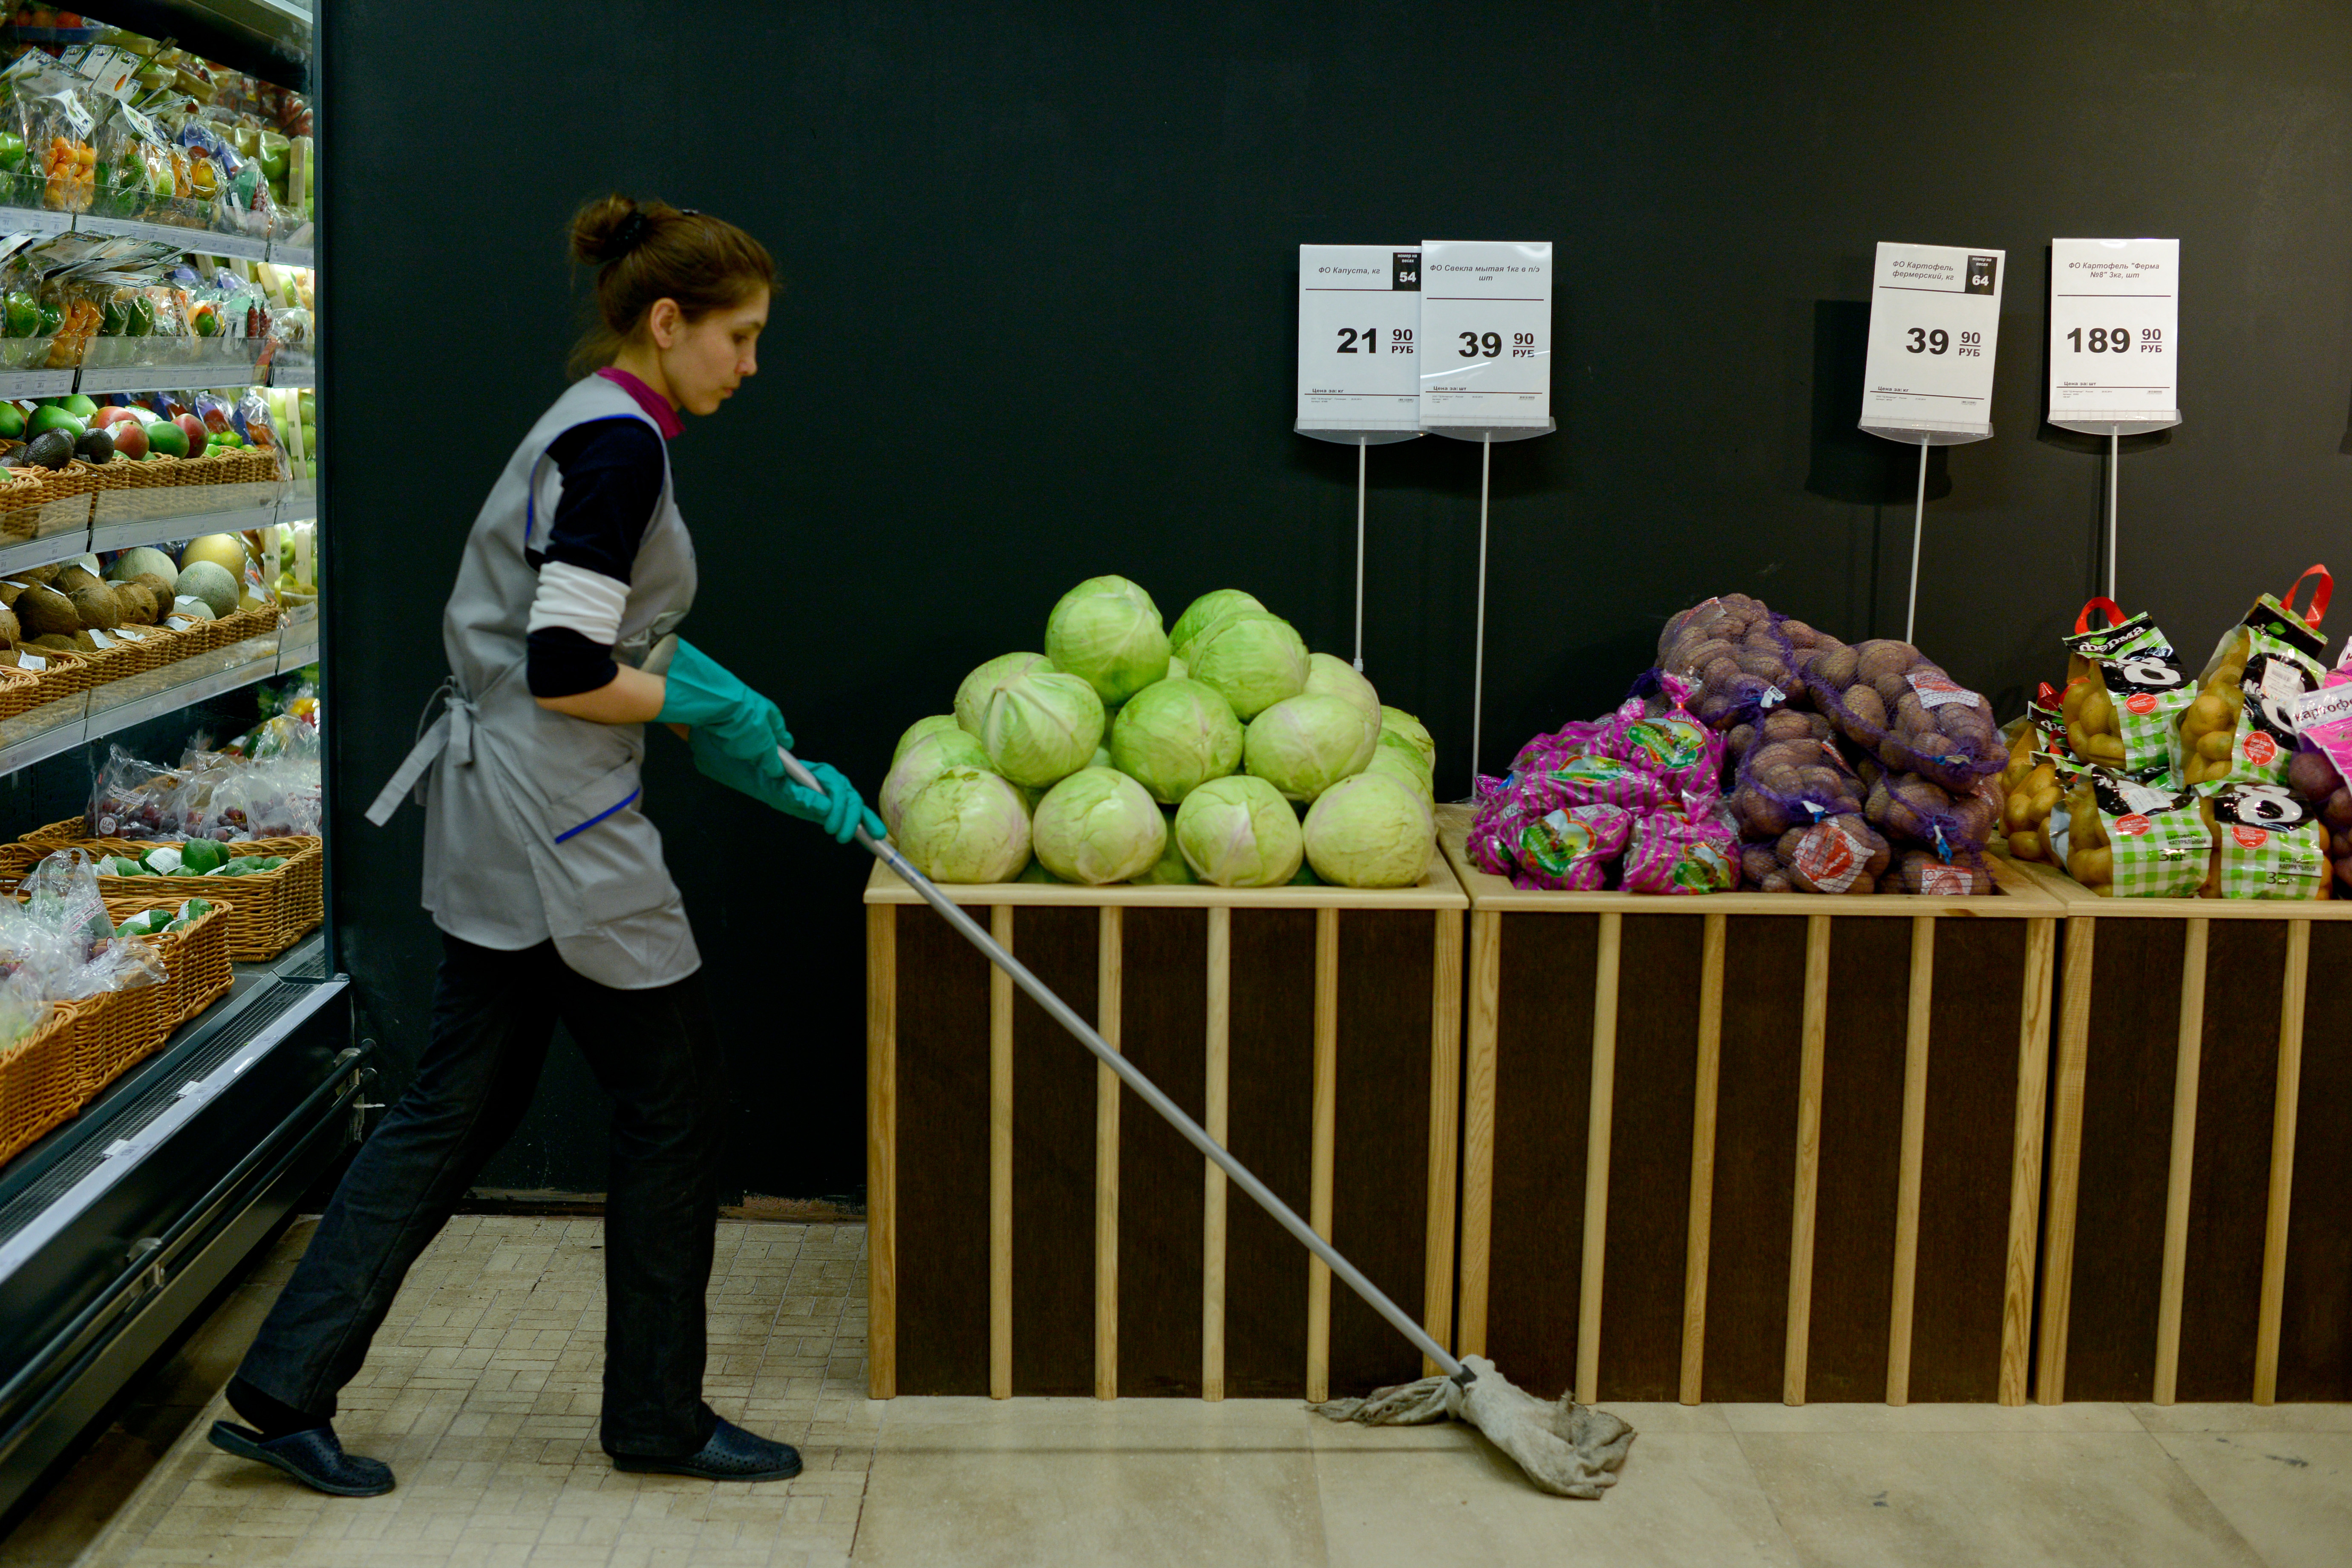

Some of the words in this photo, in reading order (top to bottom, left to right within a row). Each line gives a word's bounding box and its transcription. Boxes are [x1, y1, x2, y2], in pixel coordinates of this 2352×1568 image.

[1333, 267, 1369, 275] Капуста,
[1906, 261, 1954, 271] Картофель
[2082, 262, 2129, 271] Картофель
[2131, 262, 2159, 271] "Ферма
[1399, 271, 1416, 282] 54
[1892, 270, 1943, 280] фермерский,
[1972, 274, 1989, 286] 64
[1392, 329, 1413, 341] 90
[1514, 333, 1534, 345] 90
[1961, 331, 1980, 344] 90
[2142, 329, 2161, 340] 90
[1337, 328, 1376, 354] 21
[1458, 331, 1502, 358] 39
[1905, 327, 1949, 355] 39
[2067, 328, 2130, 353] 189
[1392, 346, 1414, 354] РУБ
[1513, 349, 1535, 357] РУБ
[1959, 348, 1980, 357] РУБ
[2141, 345, 2162, 353] РУБ
[2079, 626, 2146, 652] ферма
